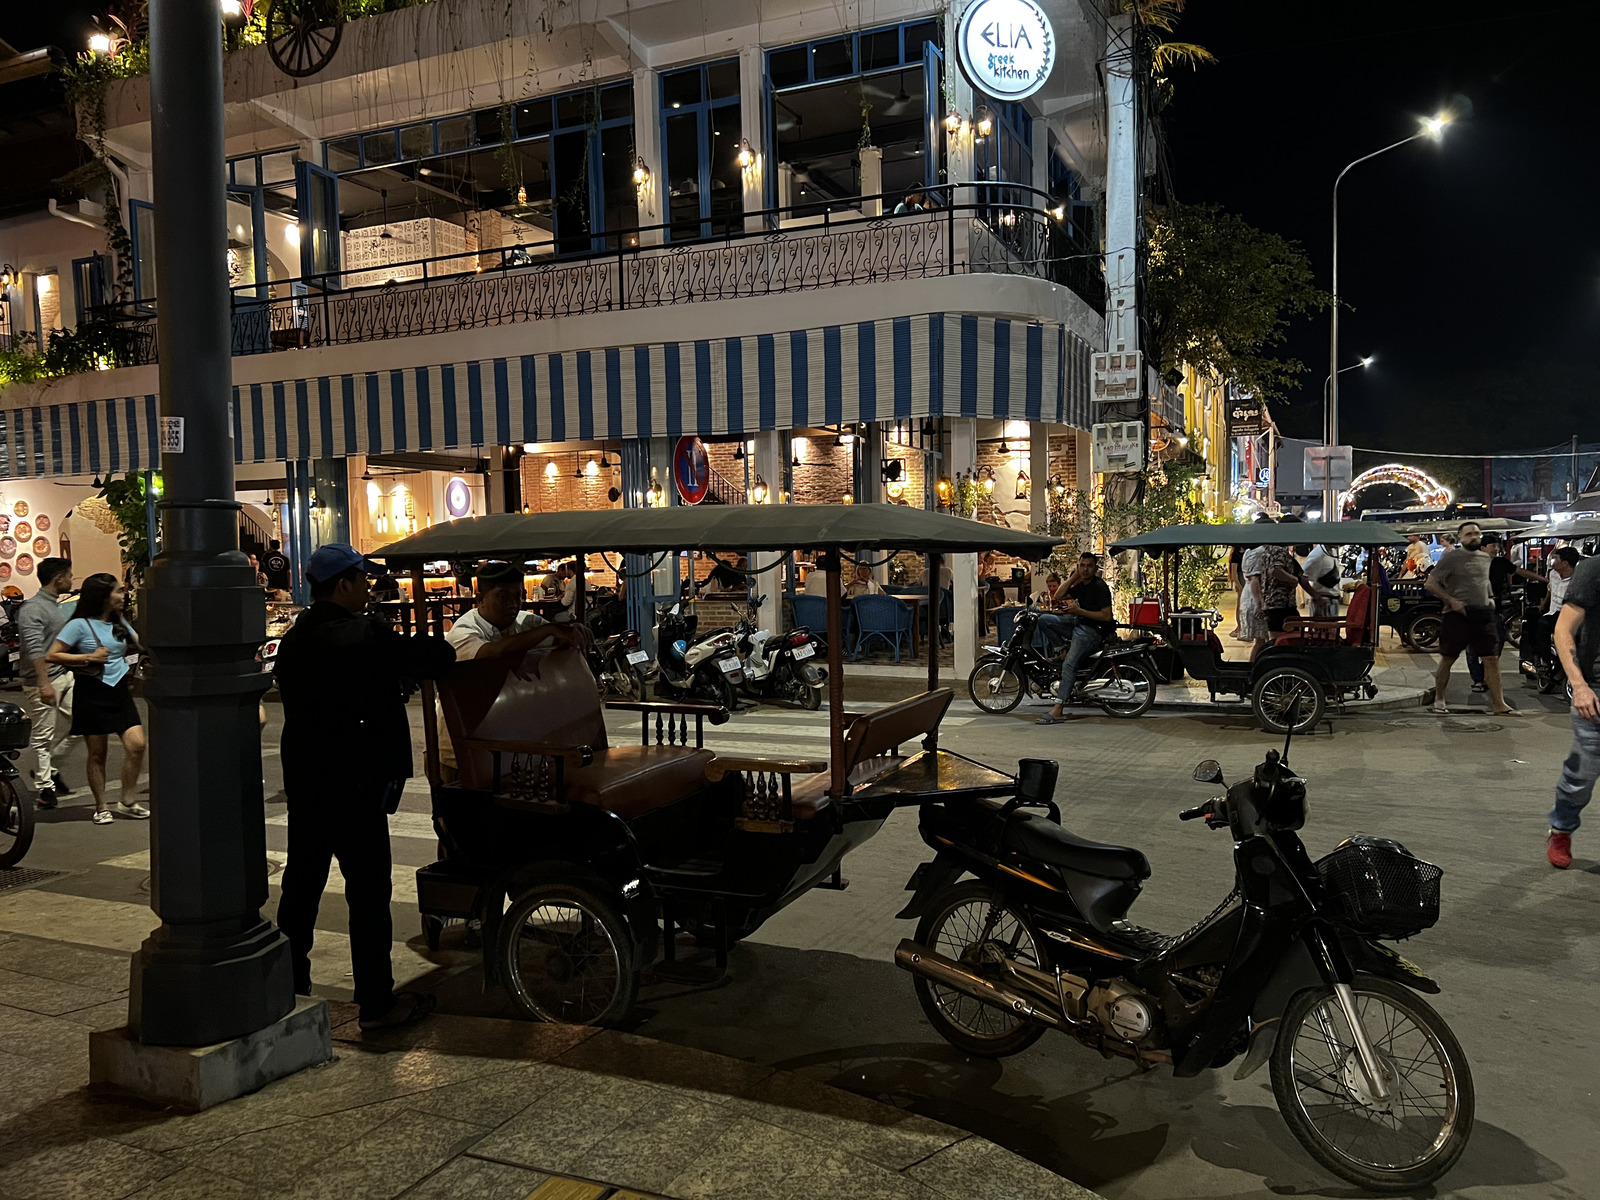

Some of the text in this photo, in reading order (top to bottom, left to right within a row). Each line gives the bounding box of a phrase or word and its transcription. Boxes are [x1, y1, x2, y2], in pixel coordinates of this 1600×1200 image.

[981, 22, 1032, 49] ELIA
[989, 53, 1015, 70] greek
[993, 65, 1030, 80] kitchen
